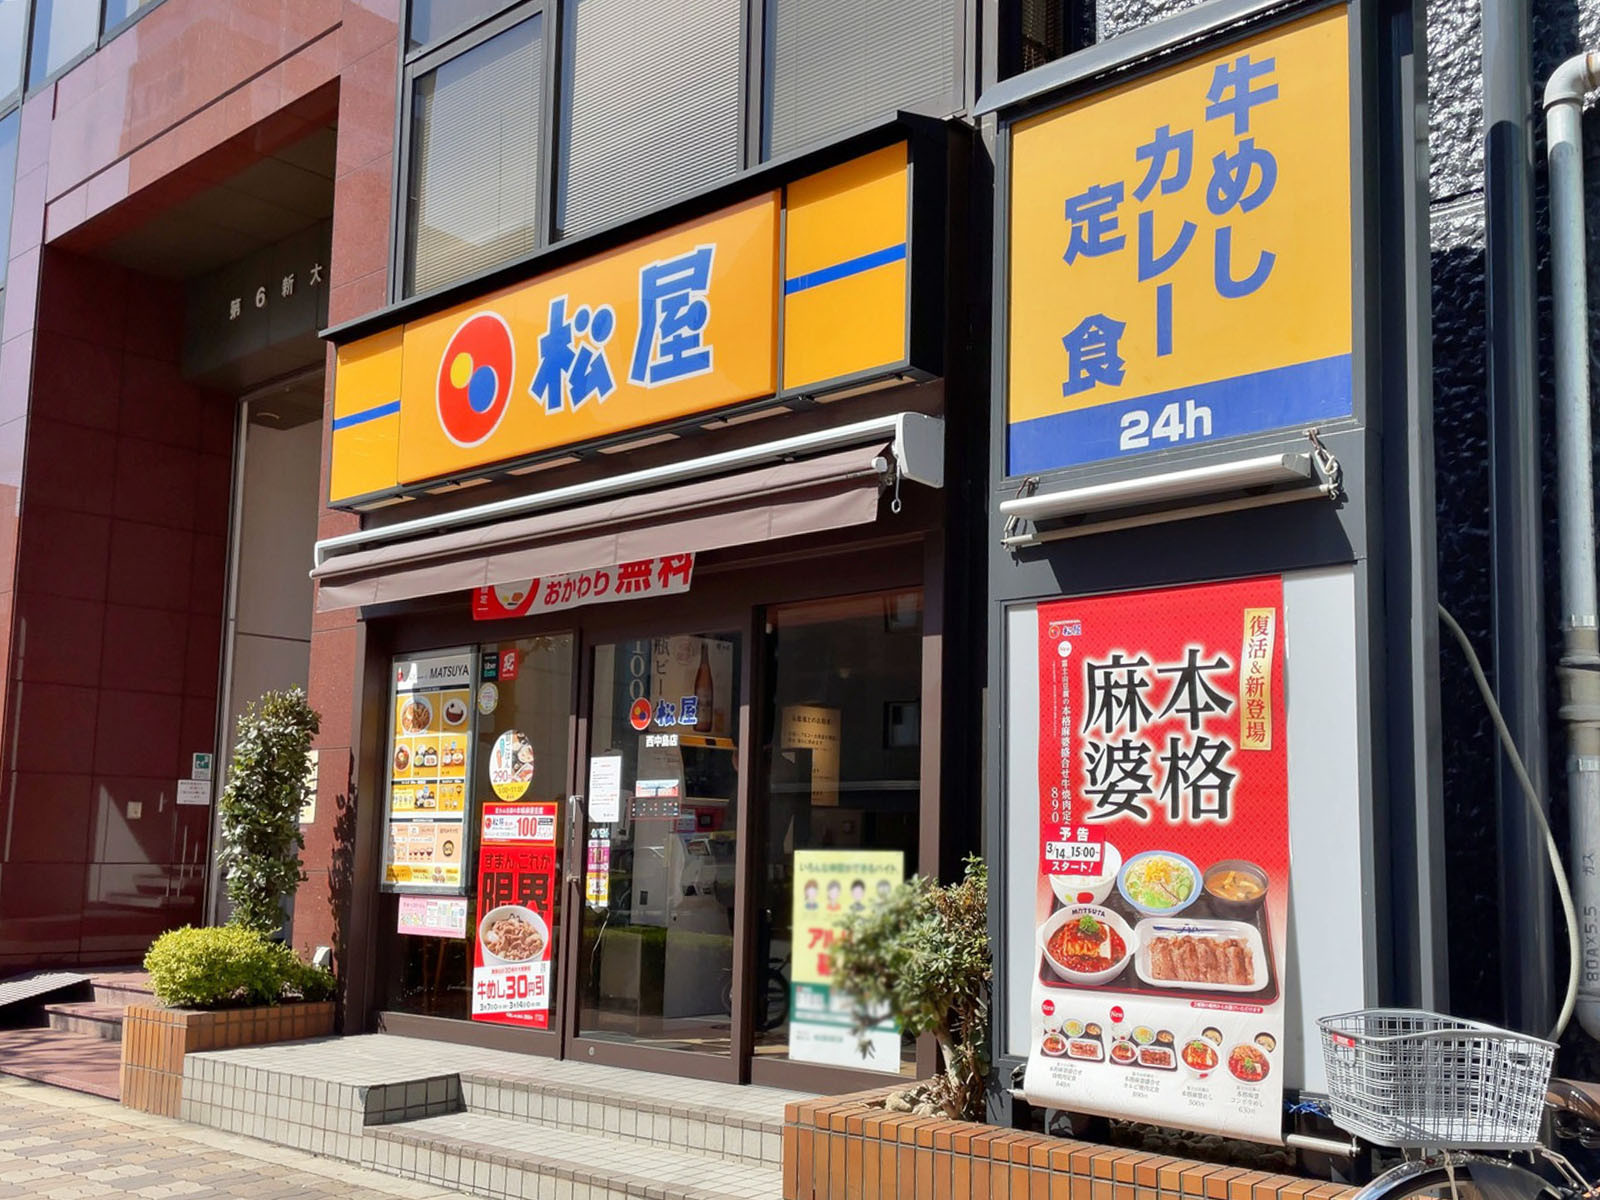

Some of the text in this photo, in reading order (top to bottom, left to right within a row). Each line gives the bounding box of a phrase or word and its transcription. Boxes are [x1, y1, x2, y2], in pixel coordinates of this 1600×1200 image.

[1205, 54, 1279, 299] 牛めし
[1132, 124, 1198, 358] カレー
[1062, 181, 1127, 397] 定食
[528, 242, 717, 415] 松屋
[1119, 400, 1213, 451] 24h
[544, 570, 611, 605] おかわり
[614, 552, 694, 594] 無料
[429, 664, 470, 679] MATSUYA
[1244, 615, 1270, 744] 復活&新登場
[654, 696, 699, 727] 松屋
[1082, 654, 1154, 820] 麻婆
[1156, 648, 1237, 820] 本格
[517, 817, 538, 837] 100
[1051, 787, 1060, 823] 890
[1059, 827, 1089, 842] 予告
